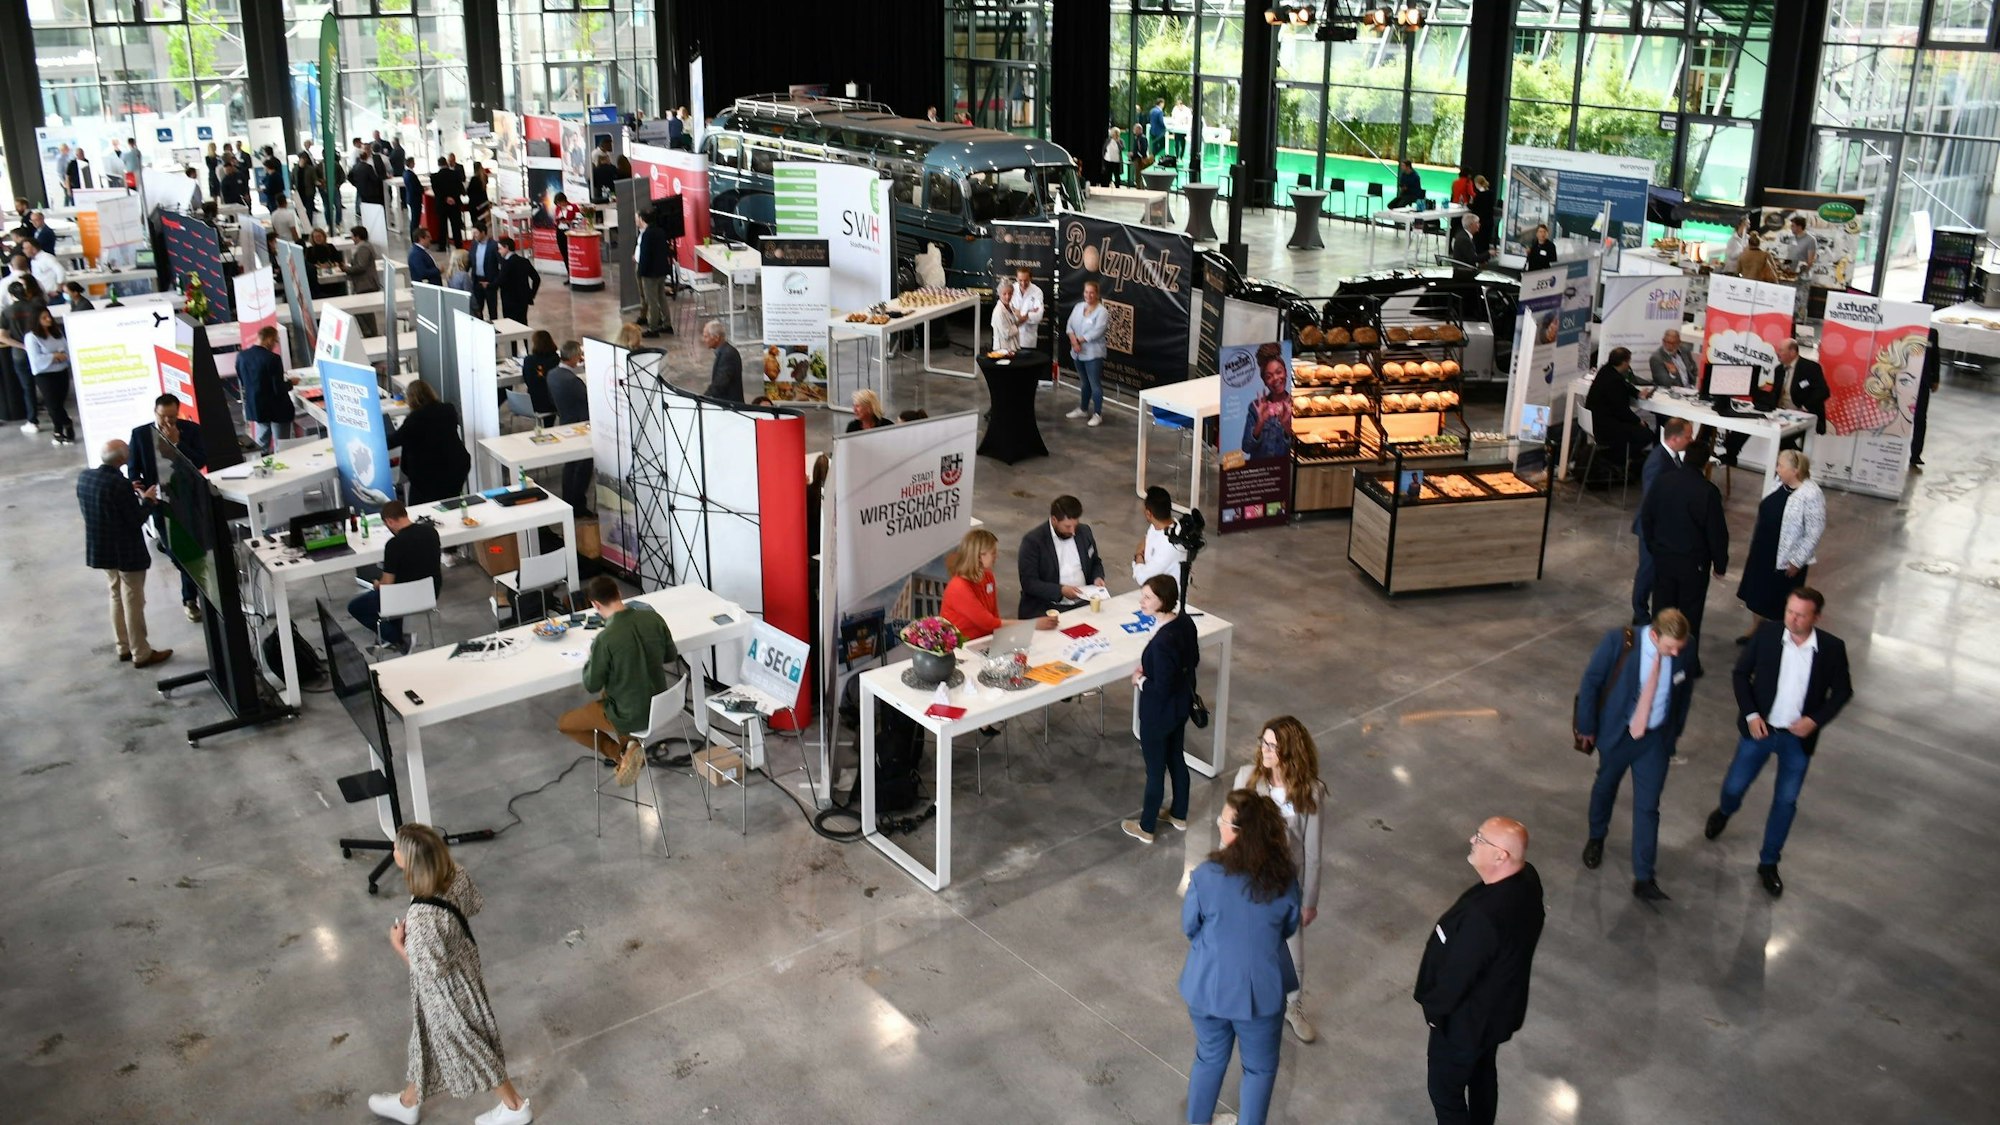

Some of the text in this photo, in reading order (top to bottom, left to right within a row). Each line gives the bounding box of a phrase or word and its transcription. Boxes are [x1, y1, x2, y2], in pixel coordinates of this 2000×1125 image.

[842, 209, 880, 243] SWH
[1004, 259, 1041, 268] SPORTSBAR
[331, 381, 364, 396] KOMPETENZ
[333, 392, 360, 405] ZENTRUM
[337, 415, 369, 430] SICHERHEIT
[911, 470, 935, 484] STADT
[900, 482, 935, 499] HÜRTH
[860, 487, 961, 526] WIRTSCHAFTS
[885, 504, 961, 537] STANDORT
